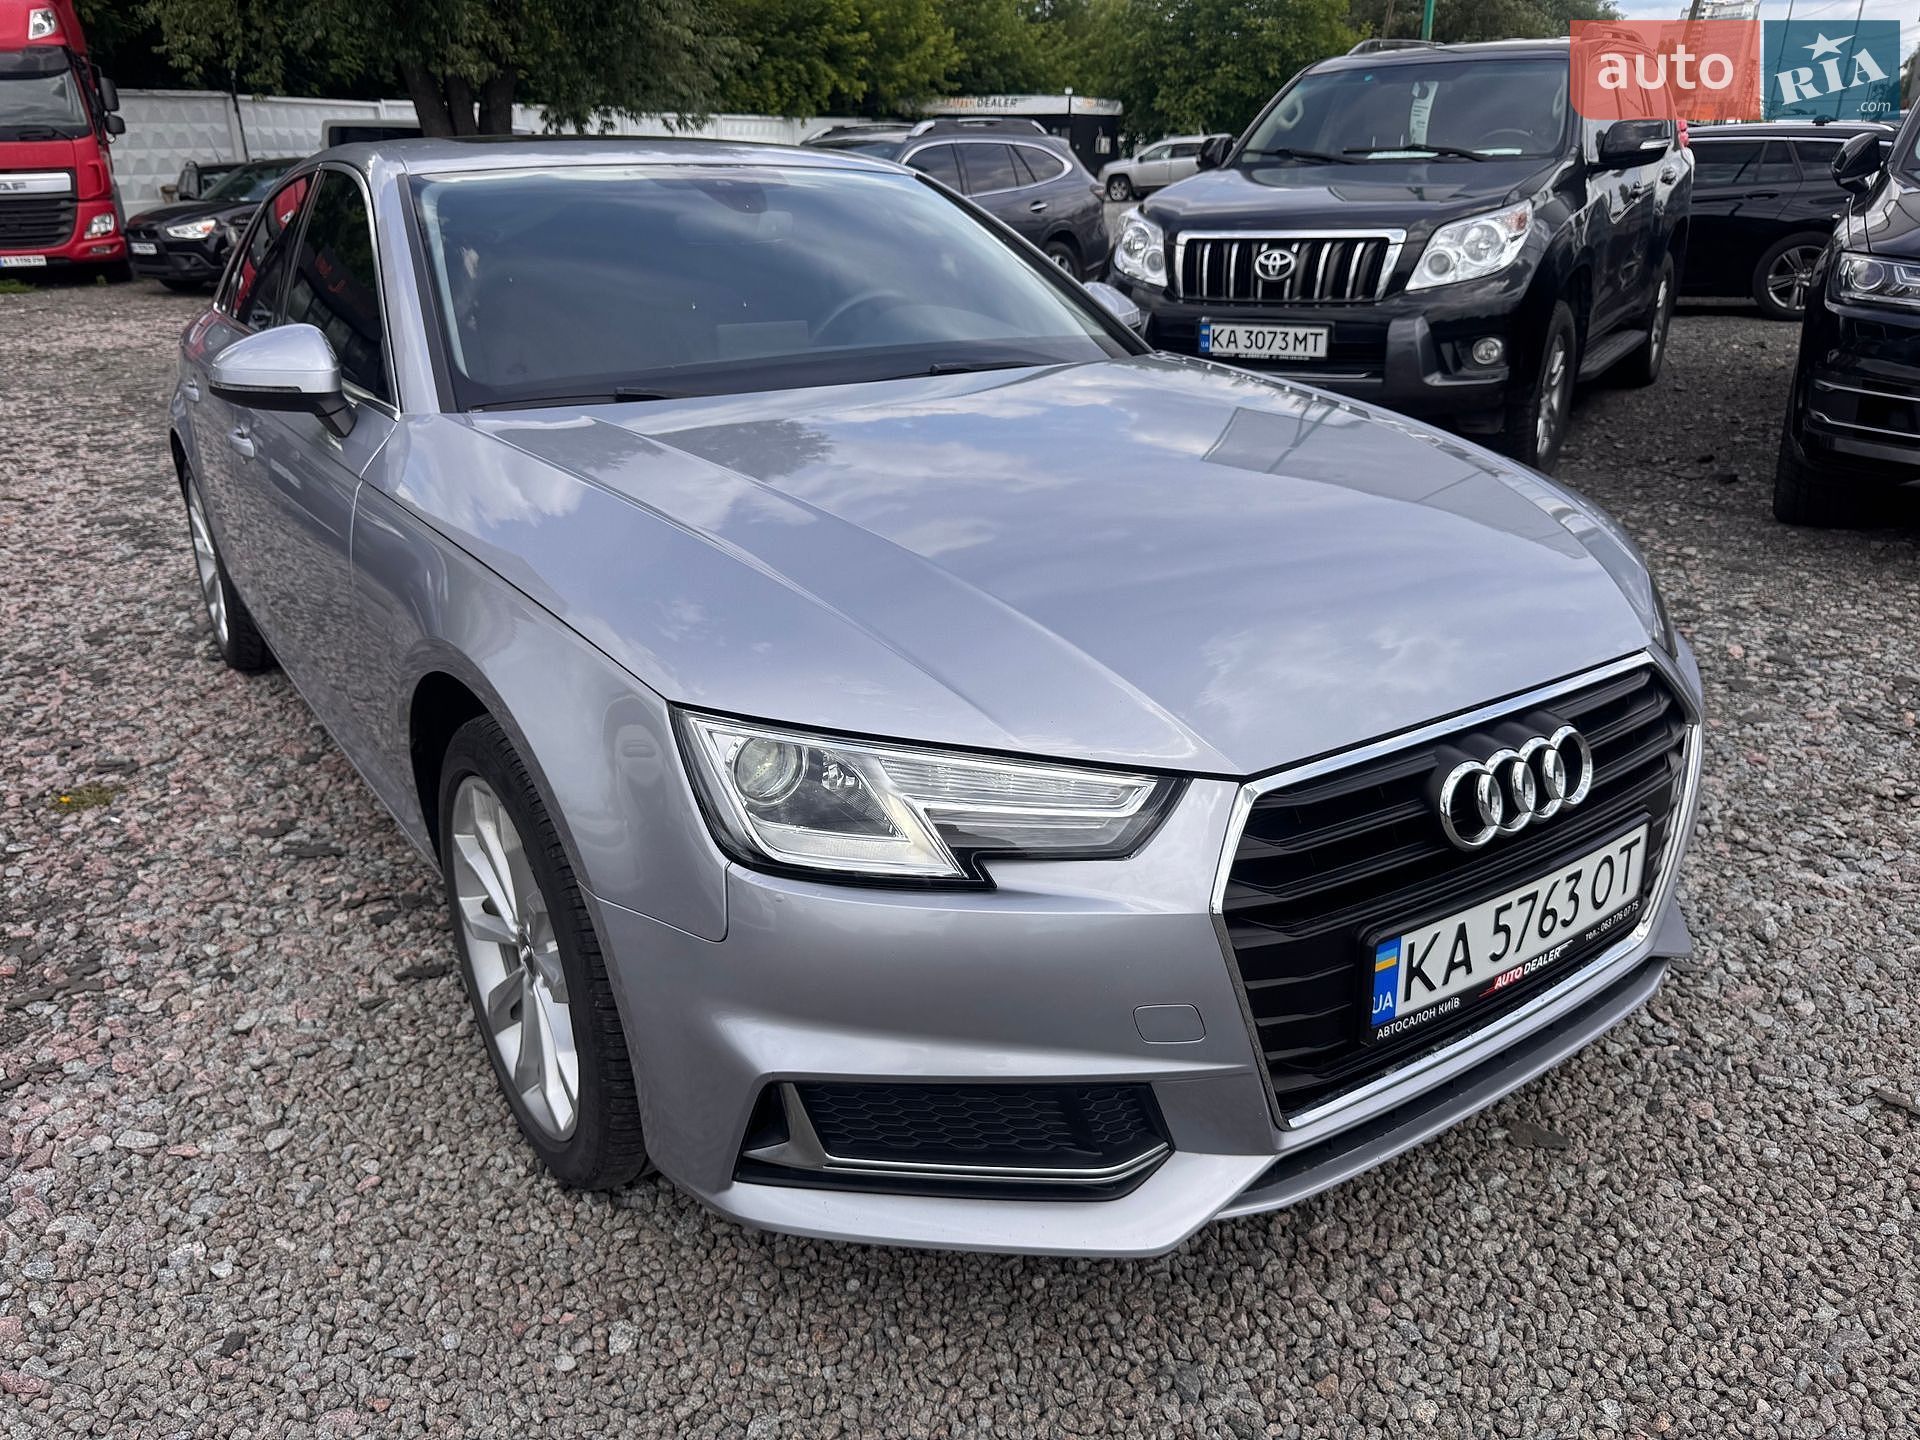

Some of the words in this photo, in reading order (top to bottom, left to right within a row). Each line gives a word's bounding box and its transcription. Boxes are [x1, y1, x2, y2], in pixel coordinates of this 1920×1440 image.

[977, 97, 1017, 108] DEALER
[1211, 328, 1238, 349] KA
[1243, 330, 1289, 350] 3073
[1293, 332, 1323, 352] MT
[1403, 921, 1473, 1003] KA
[1489, 868, 1583, 962] 5763
[1590, 837, 1641, 911] OT
[1600, 918, 1612, 932] 063
[1623, 905, 1632, 917] 07
[1631, 900, 1639, 912] 75
[1494, 966, 1523, 990] AUTO
[1523, 947, 1562, 975] DEALER
[1372, 991, 1393, 1014] UA
[1376, 1007, 1436, 1040] АВТОСАЛОН
[1438, 997, 1460, 1014] КИЇВ
